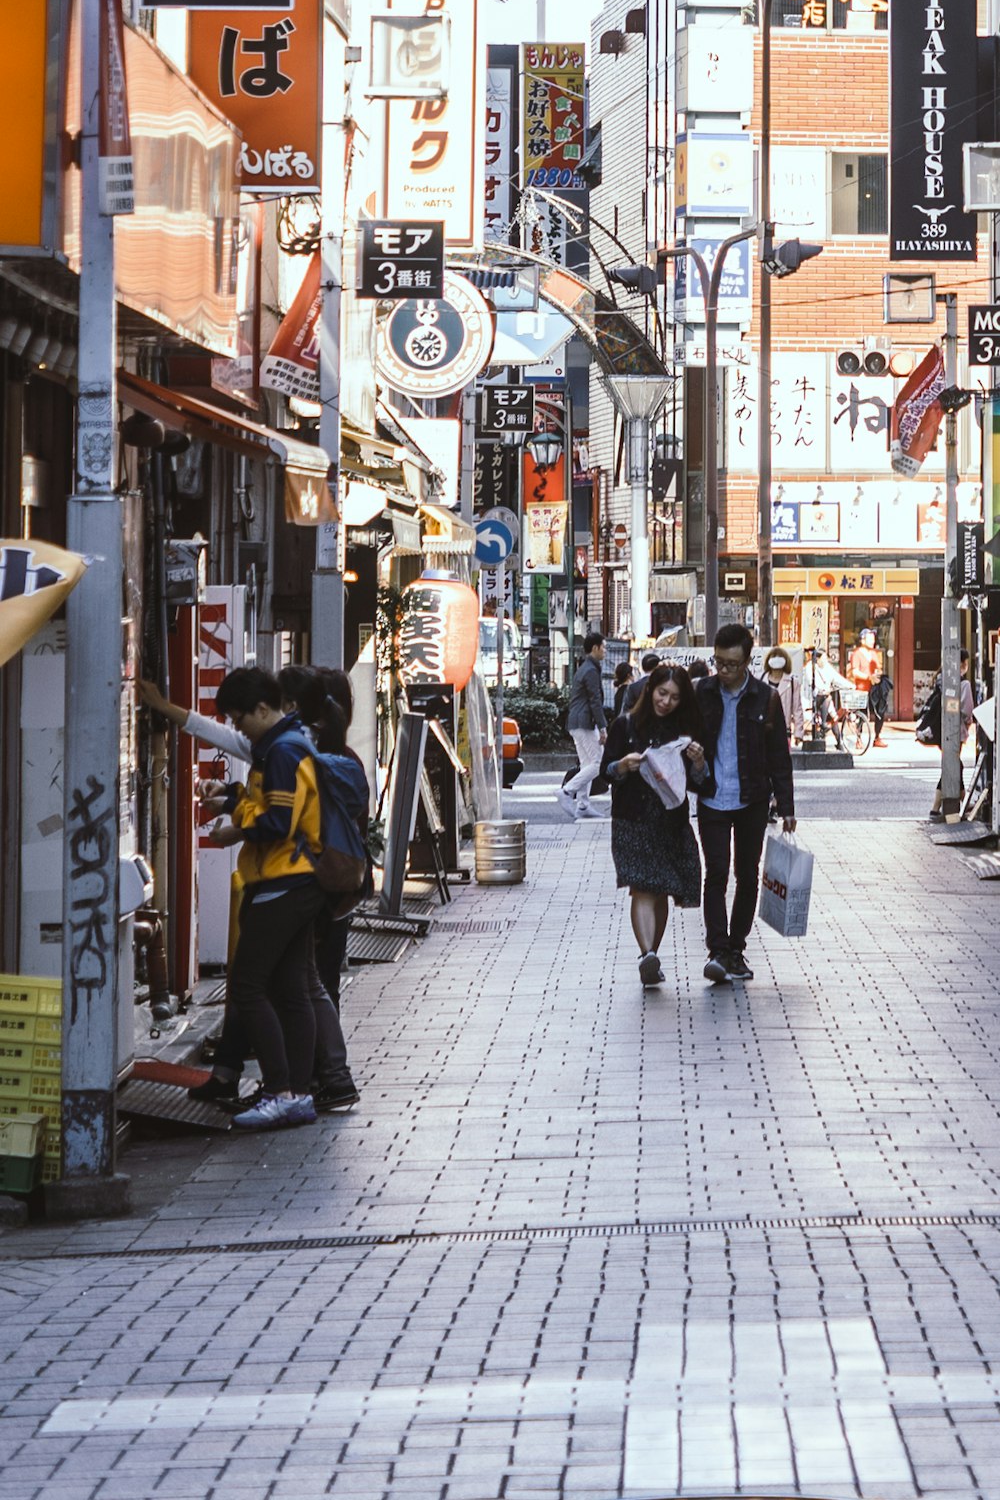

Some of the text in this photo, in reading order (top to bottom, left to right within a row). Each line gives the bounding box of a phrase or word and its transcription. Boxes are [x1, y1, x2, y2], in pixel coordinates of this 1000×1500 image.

[527, 47, 583, 69] もんじゃ
[528, 81, 552, 157] お好み焼
[922, 87, 946, 198] HOUSE
[374, 228, 433, 254] モア
[921, 224, 946, 238] 389
[895, 240, 972, 251] HAYASHIYA
[374, 262, 431, 294] 3番街
[692, 347, 747, 363] 石ビル
[493, 390, 528, 405] モア
[493, 409, 527, 428] 3番街
[794, 376, 815, 447] 牛たん
[840, 574, 874, 589] 松屋
